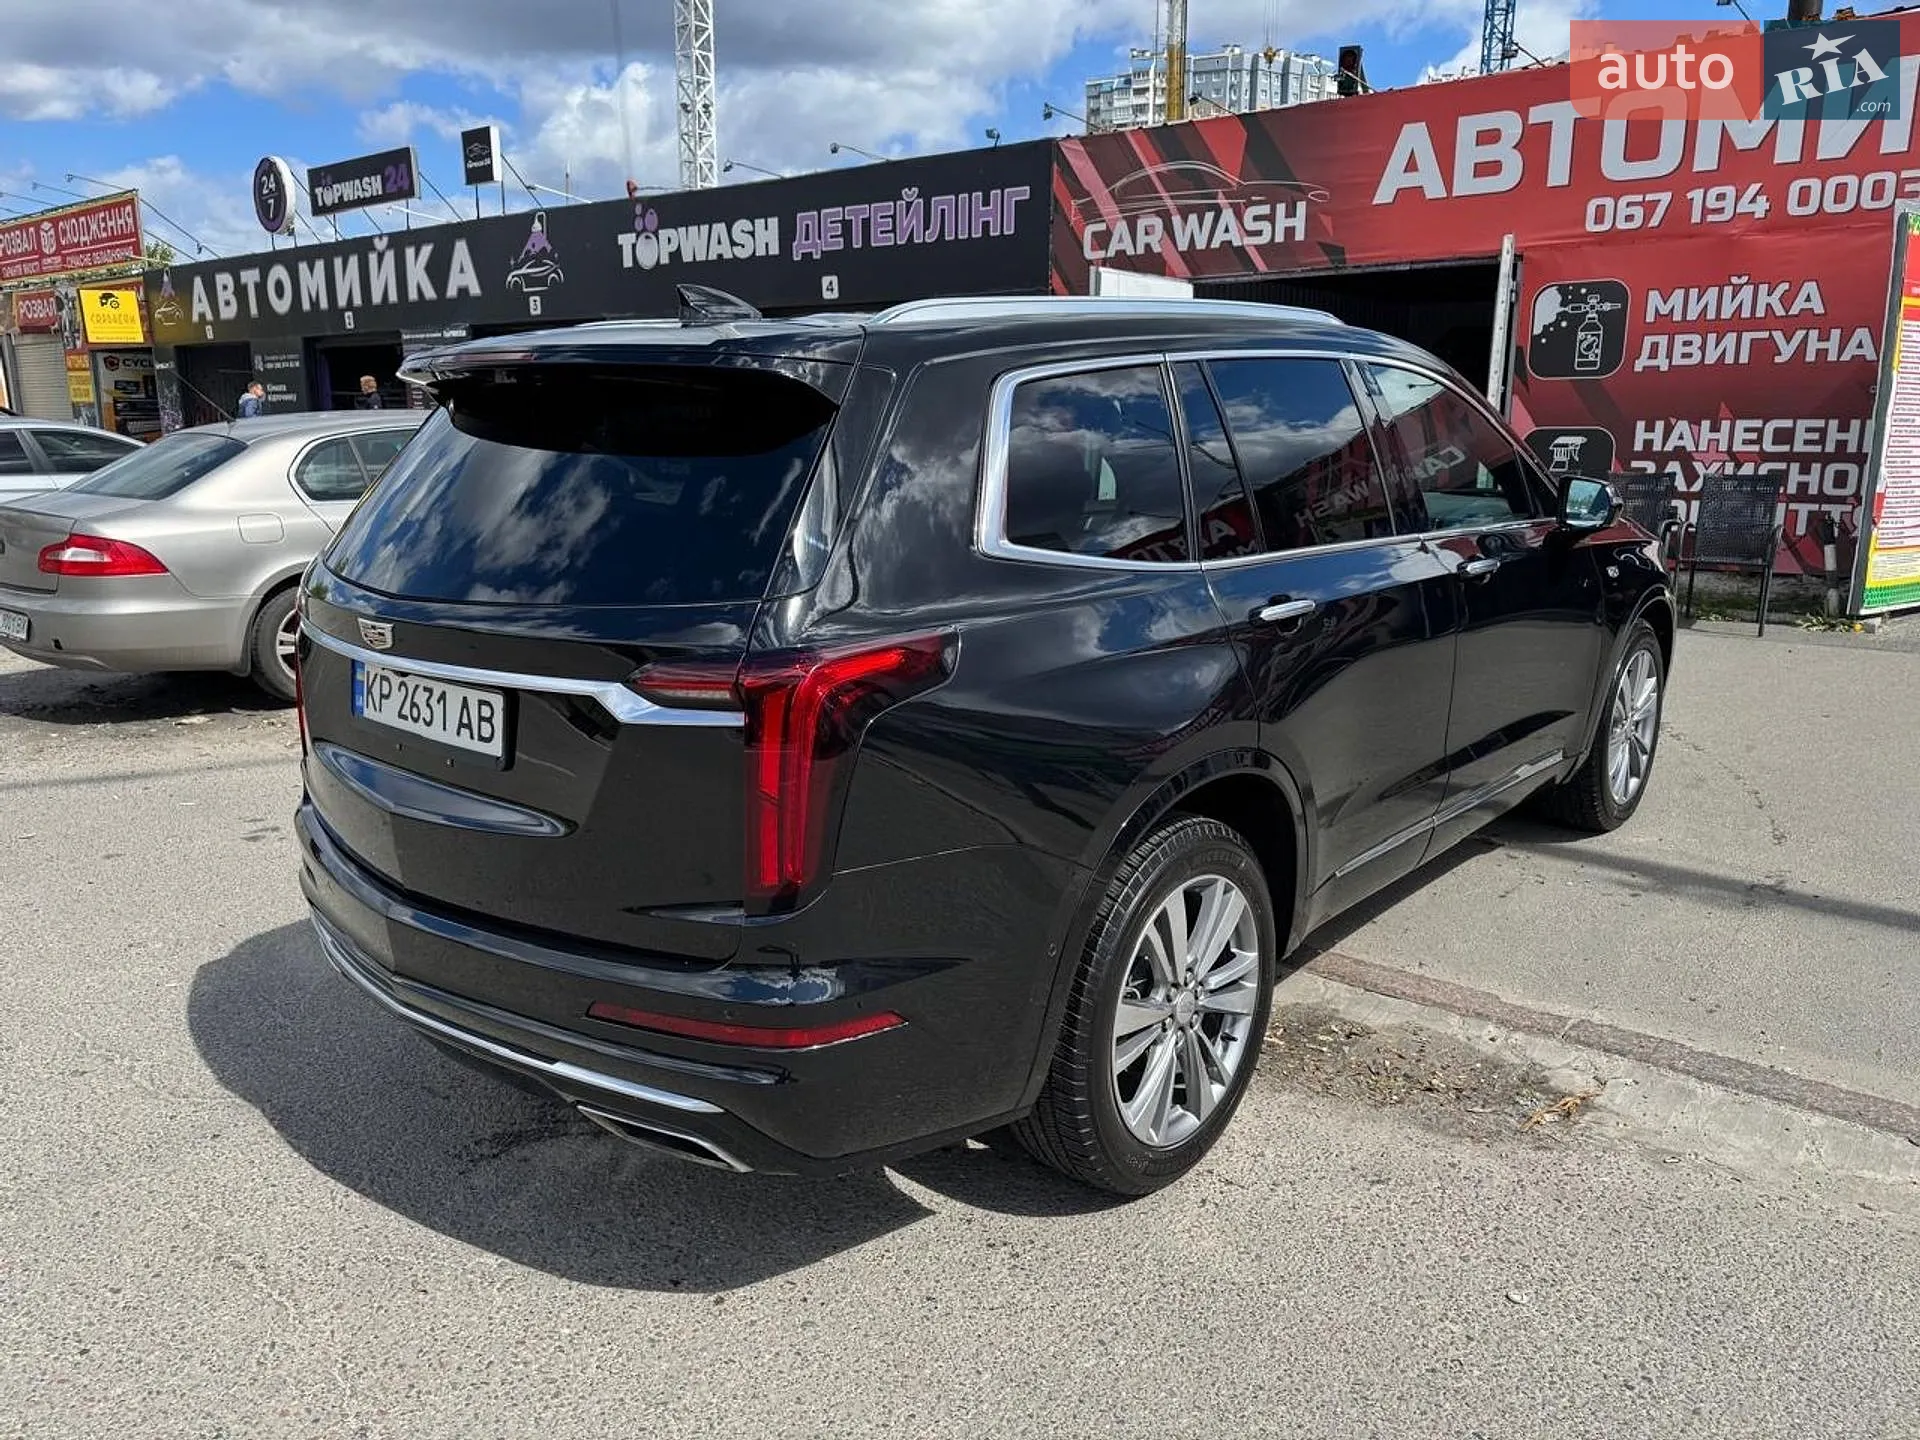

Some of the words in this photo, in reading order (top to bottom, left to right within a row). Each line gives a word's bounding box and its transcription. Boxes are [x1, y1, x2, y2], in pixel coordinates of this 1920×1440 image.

[260, 174, 276, 194] 24
[315, 174, 383, 206] TOPWASH
[384, 163, 410, 193] 24
[1585, 191, 1673, 233] 067
[1686, 182, 1770, 224] 194
[58, 205, 135, 247] СХОДЖЕННЯ
[267, 199, 275, 220] 7
[792, 186, 1031, 261] ДЕТЕЙЛІНГ
[1083, 215, 1164, 261] CAR
[1172, 201, 1307, 252] WASH
[617, 216, 780, 271] TOPWASH
[190, 235, 482, 325] АВТОМИЙКА
[1644, 275, 1826, 323] МИЙКА
[19, 296, 57, 320] РОЗВАЛ
[1633, 327, 1878, 373] ДВИГУНА
[365, 669, 393, 713] KP
[396, 680, 448, 732] 2631
[456, 695, 496, 744] AB
